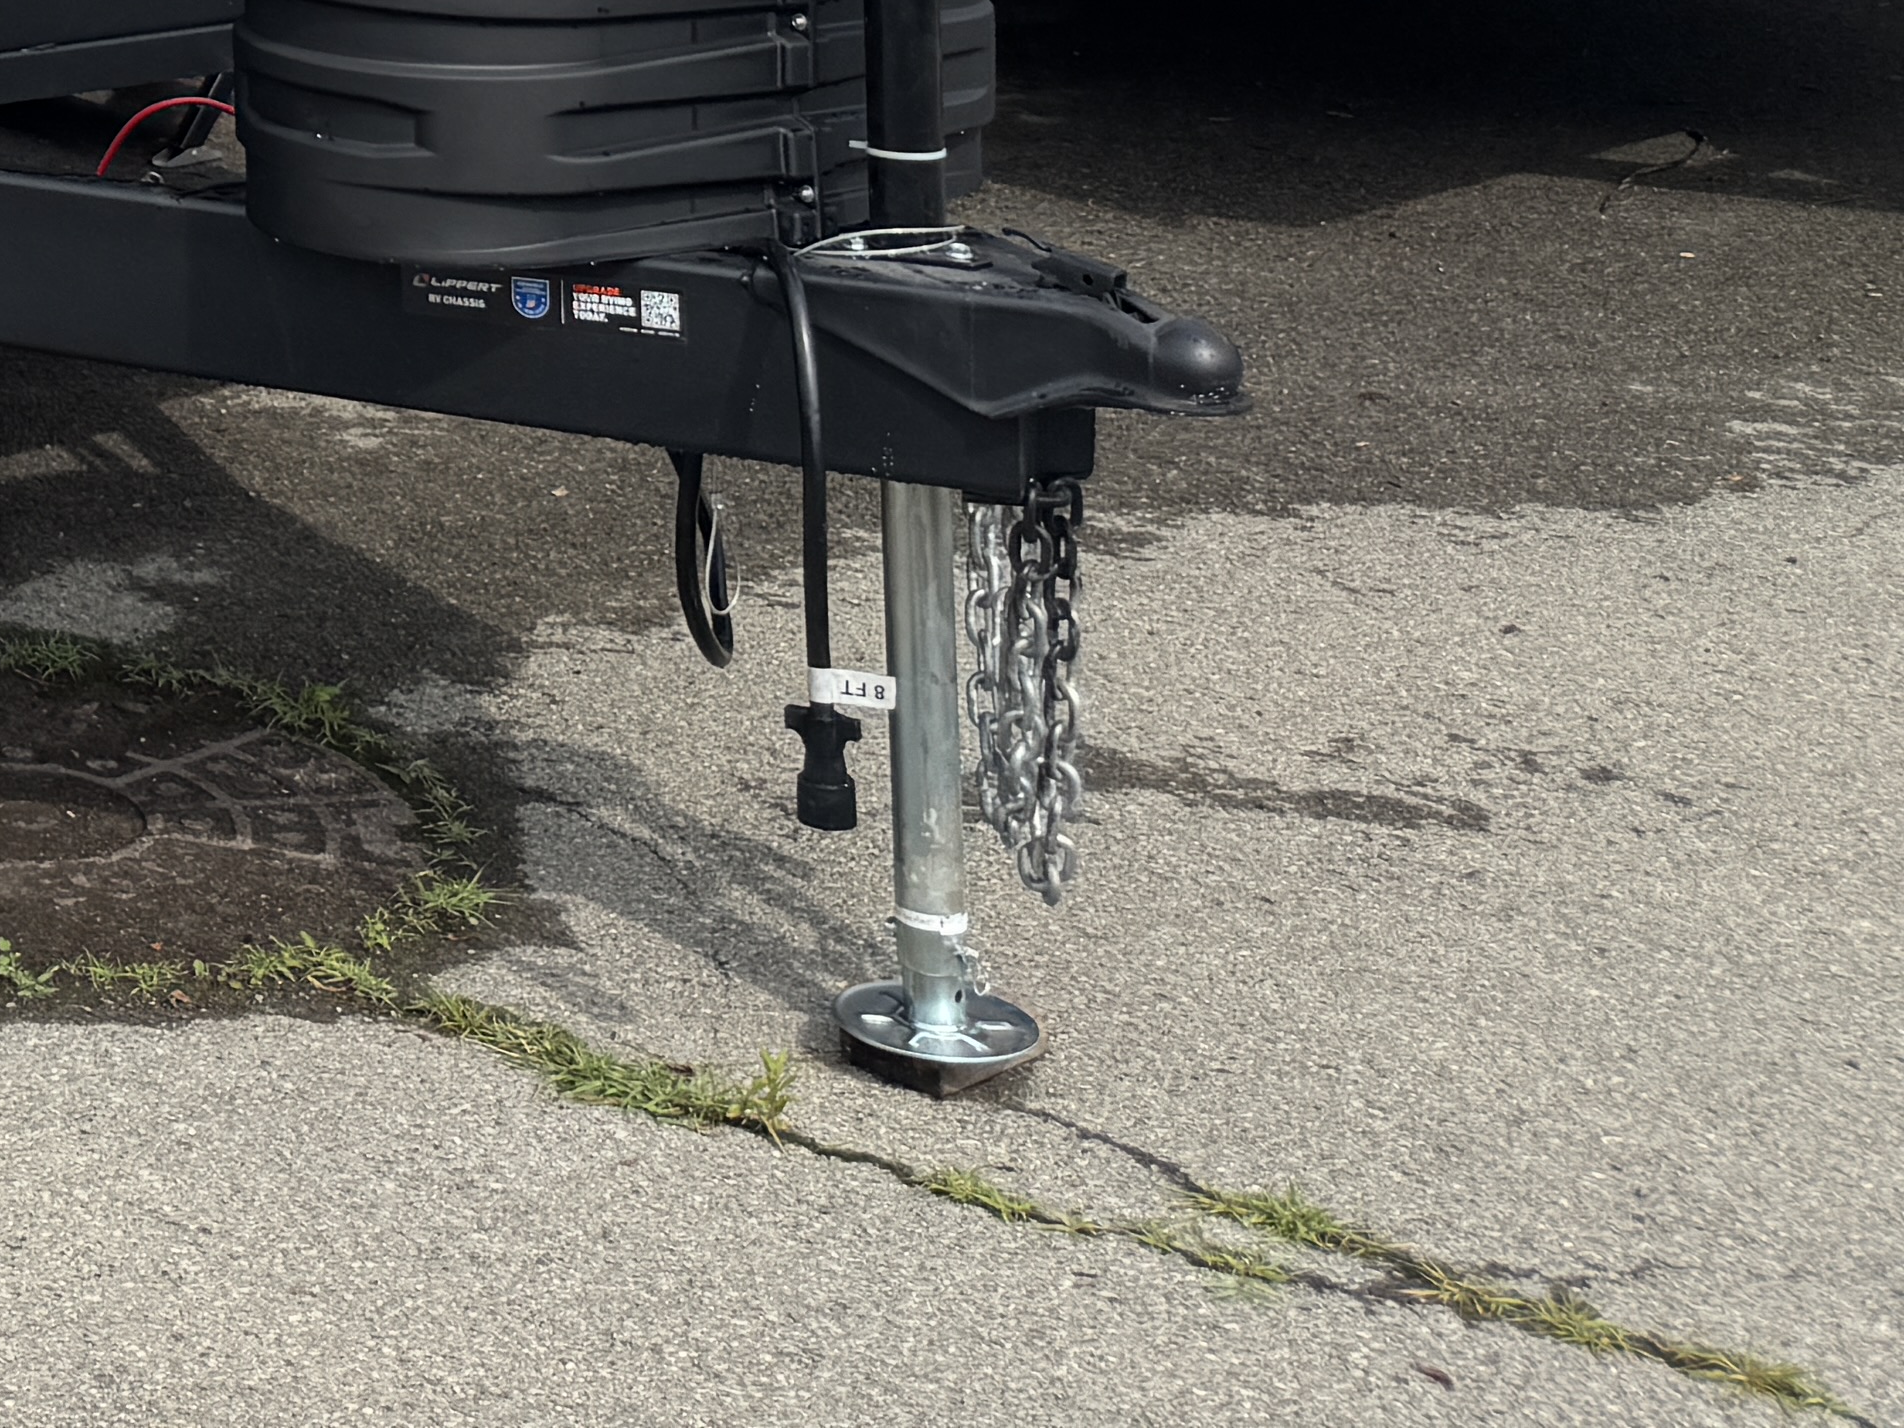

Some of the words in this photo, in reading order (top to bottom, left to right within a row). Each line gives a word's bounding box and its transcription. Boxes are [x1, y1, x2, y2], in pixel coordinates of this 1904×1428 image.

[442, 295, 486, 309] CHASSIS
[840, 679, 867, 698] FT
[874, 685, 885, 700] 8
